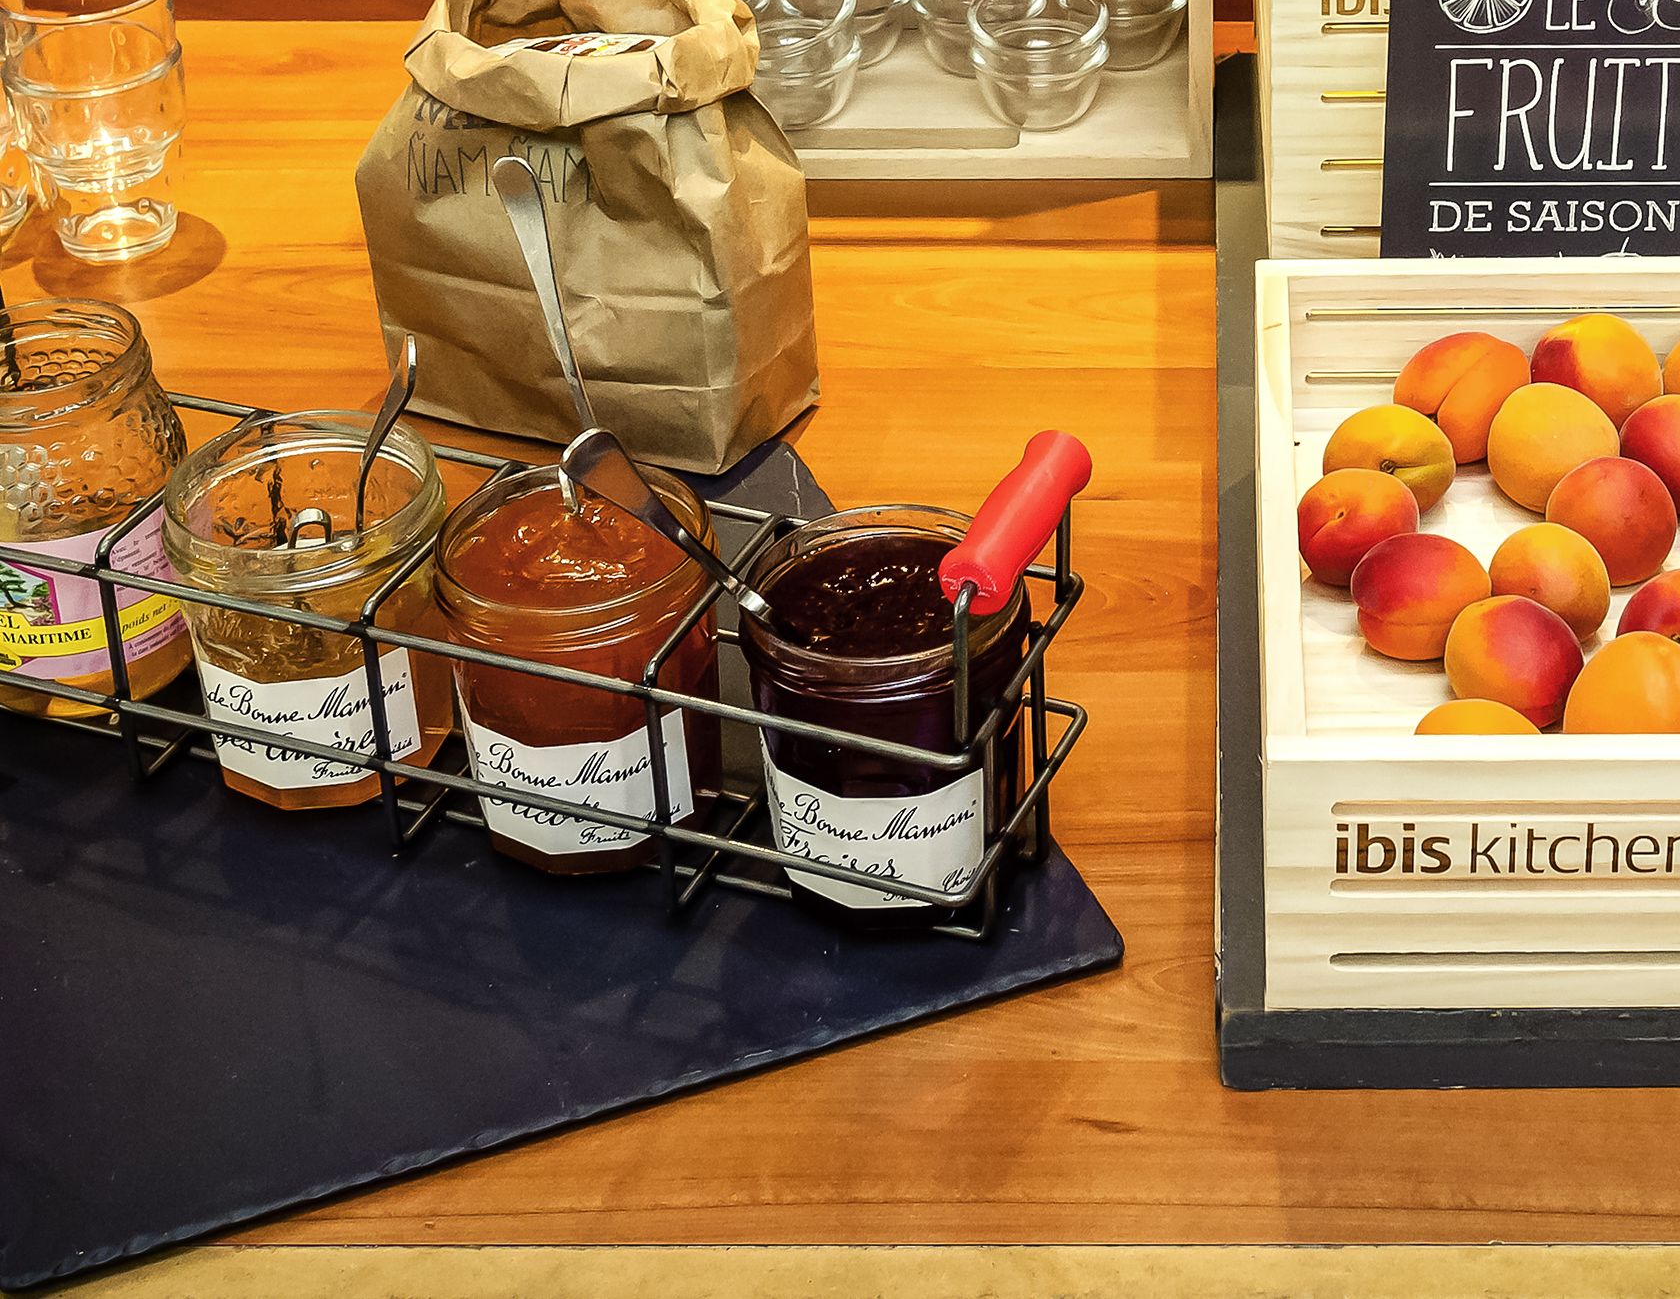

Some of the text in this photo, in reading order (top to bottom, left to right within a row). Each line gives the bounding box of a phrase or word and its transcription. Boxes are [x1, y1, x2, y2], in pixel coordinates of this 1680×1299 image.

[1428, 199, 1680, 233] DE SAISON
[3, 628, 92, 645] MARITIME
[229, 684, 304, 724] Bonne
[489, 742, 562, 788] Bonne
[565, 750, 652, 787] Mama
[794, 793, 869, 841] Bonne
[872, 806, 975, 841] Maman
[1335, 822, 1452, 874] ibis
